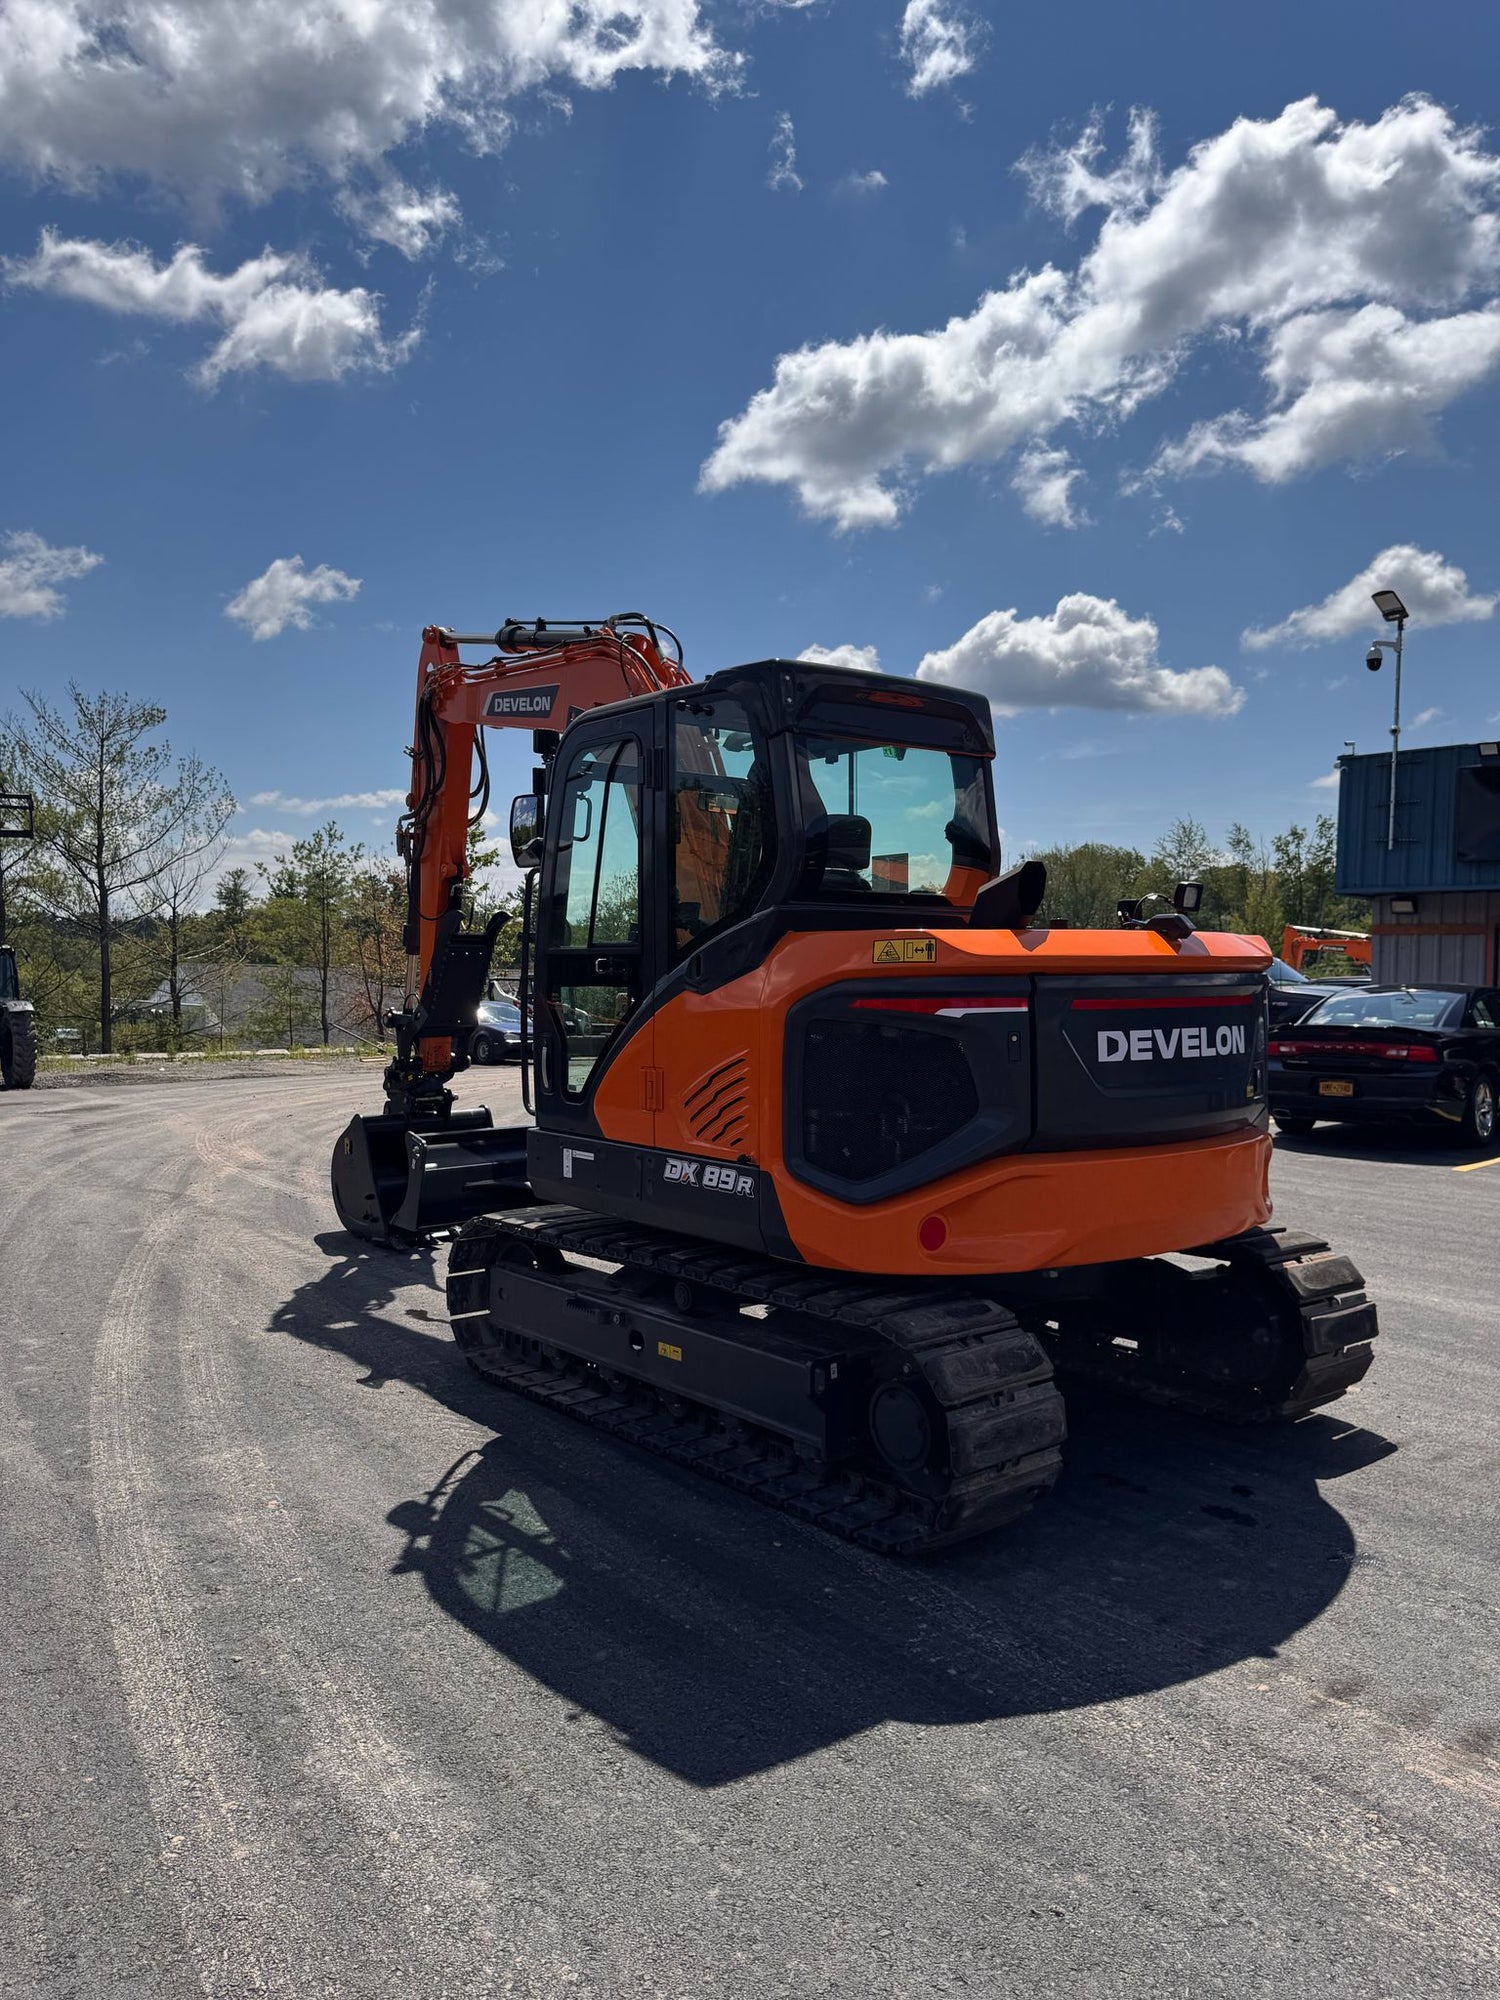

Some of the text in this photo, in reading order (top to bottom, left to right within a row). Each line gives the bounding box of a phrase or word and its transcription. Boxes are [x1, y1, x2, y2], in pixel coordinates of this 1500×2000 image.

[494, 697, 551, 712] DEVELON
[1097, 1025, 1245, 1062] DEVELON
[663, 1157, 699, 1187] DX
